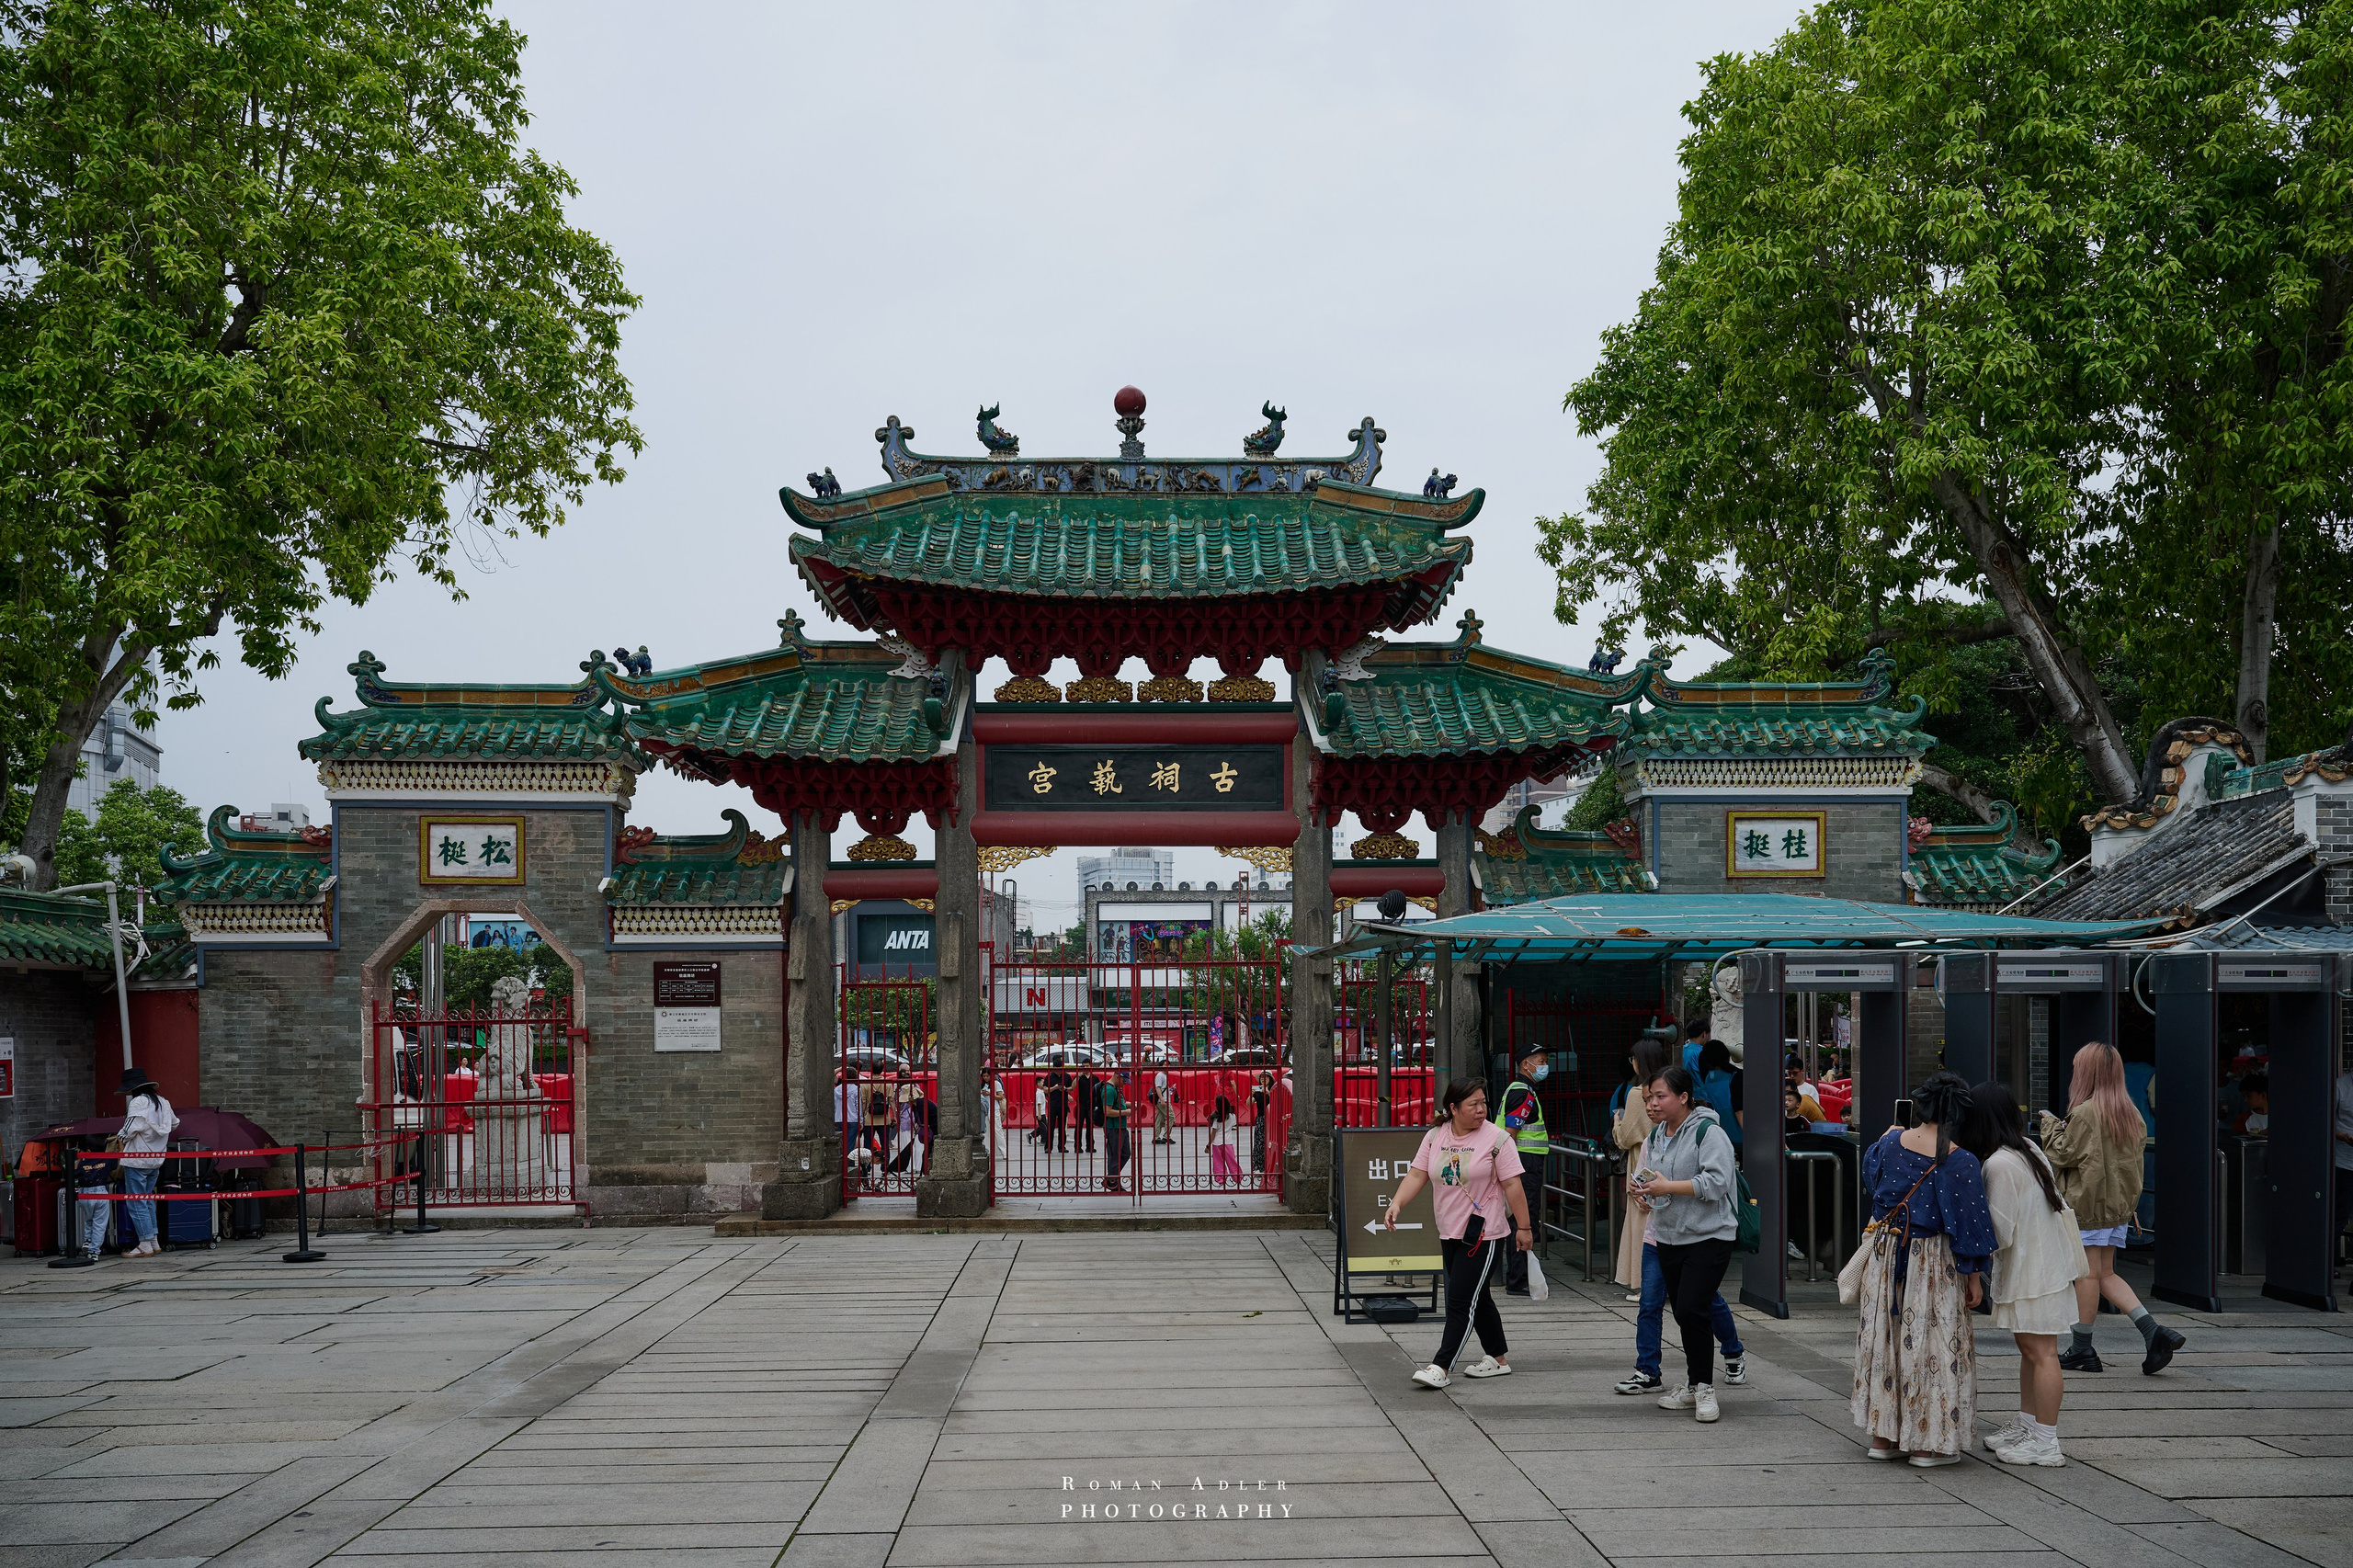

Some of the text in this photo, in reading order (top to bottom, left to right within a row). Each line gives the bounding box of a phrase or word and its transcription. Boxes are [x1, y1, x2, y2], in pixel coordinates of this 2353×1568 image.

[883, 930, 929, 949] ANTA
[1027, 987, 1046, 1006] N
[1369, 1158, 1412, 1180] 出口
